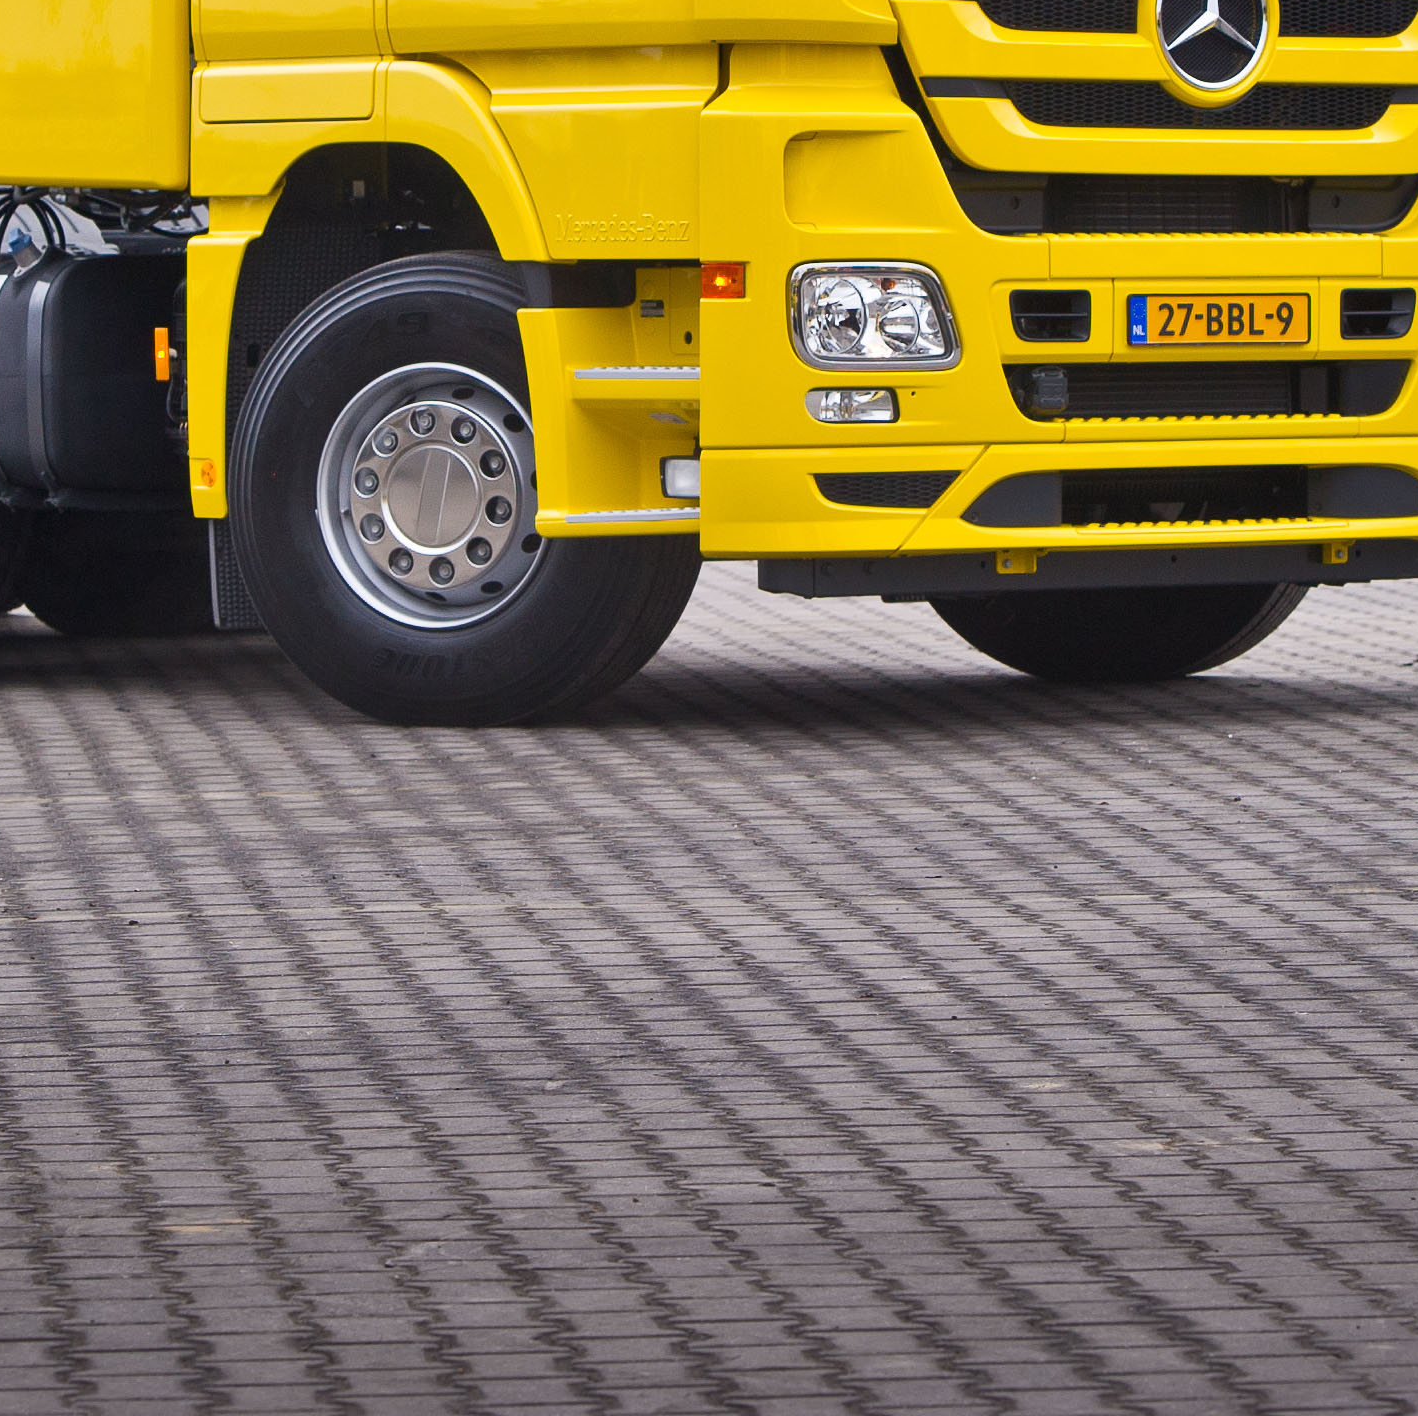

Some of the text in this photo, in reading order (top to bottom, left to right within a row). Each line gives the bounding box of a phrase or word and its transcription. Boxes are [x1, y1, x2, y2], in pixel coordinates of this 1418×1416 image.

[555, 213, 691, 243] Mercedes-Benz
[1132, 324, 1146, 337] NL
[1158, 301, 1294, 337] 27-BBL-9
